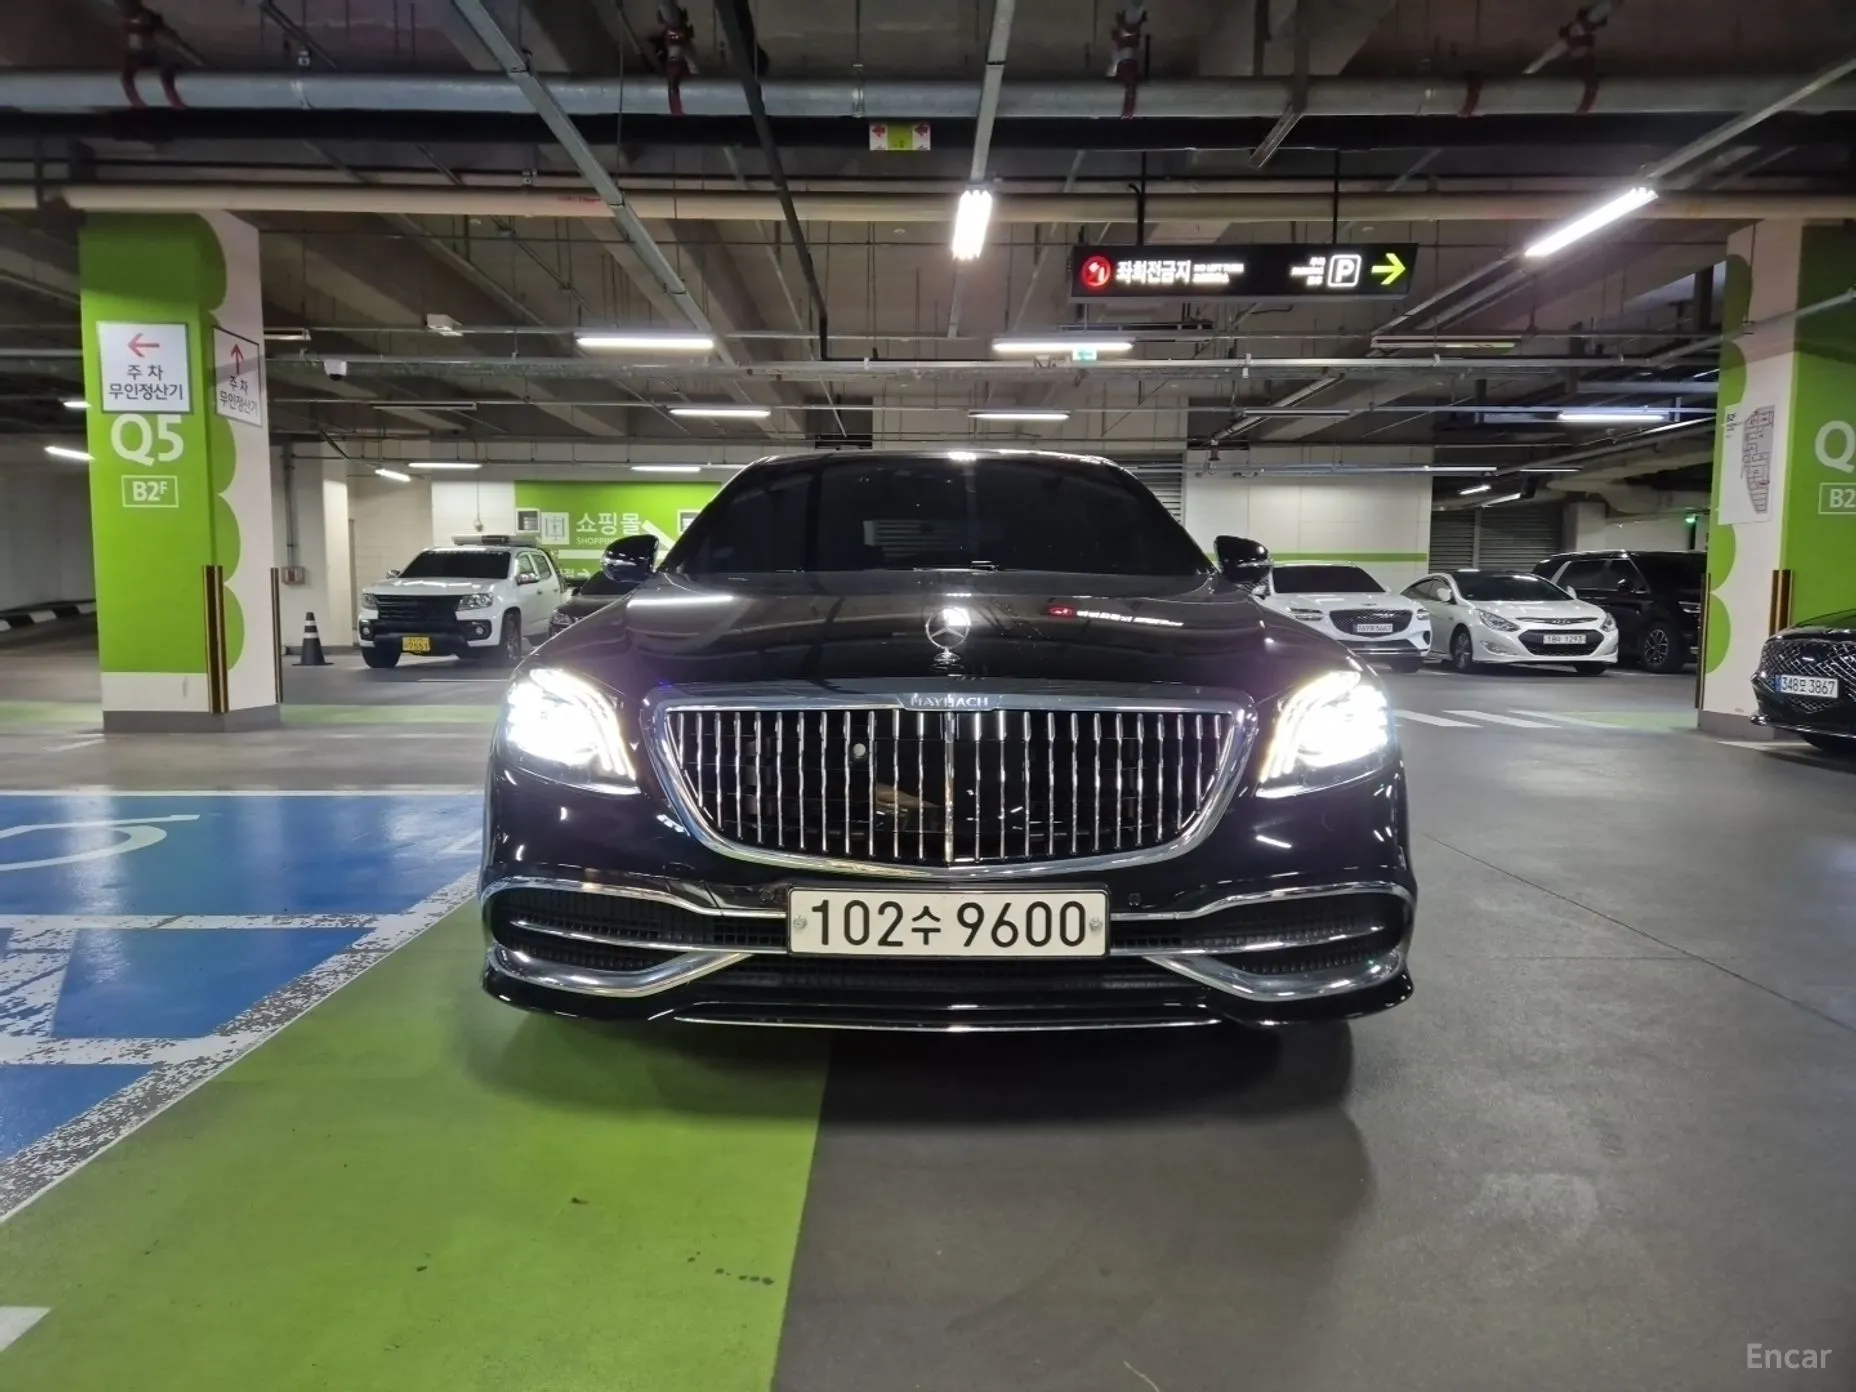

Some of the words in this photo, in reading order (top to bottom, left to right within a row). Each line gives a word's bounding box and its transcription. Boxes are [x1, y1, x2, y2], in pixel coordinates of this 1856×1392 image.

[1116, 259, 1191, 284] 좌회전금지
[108, 383, 184, 400] 무인정산기
[110, 413, 184, 466] Q5
[132, 480, 168, 502] B2F
[576, 512, 642, 536] 쇼핑몰
[911, 692, 989, 708] MAYBACH
